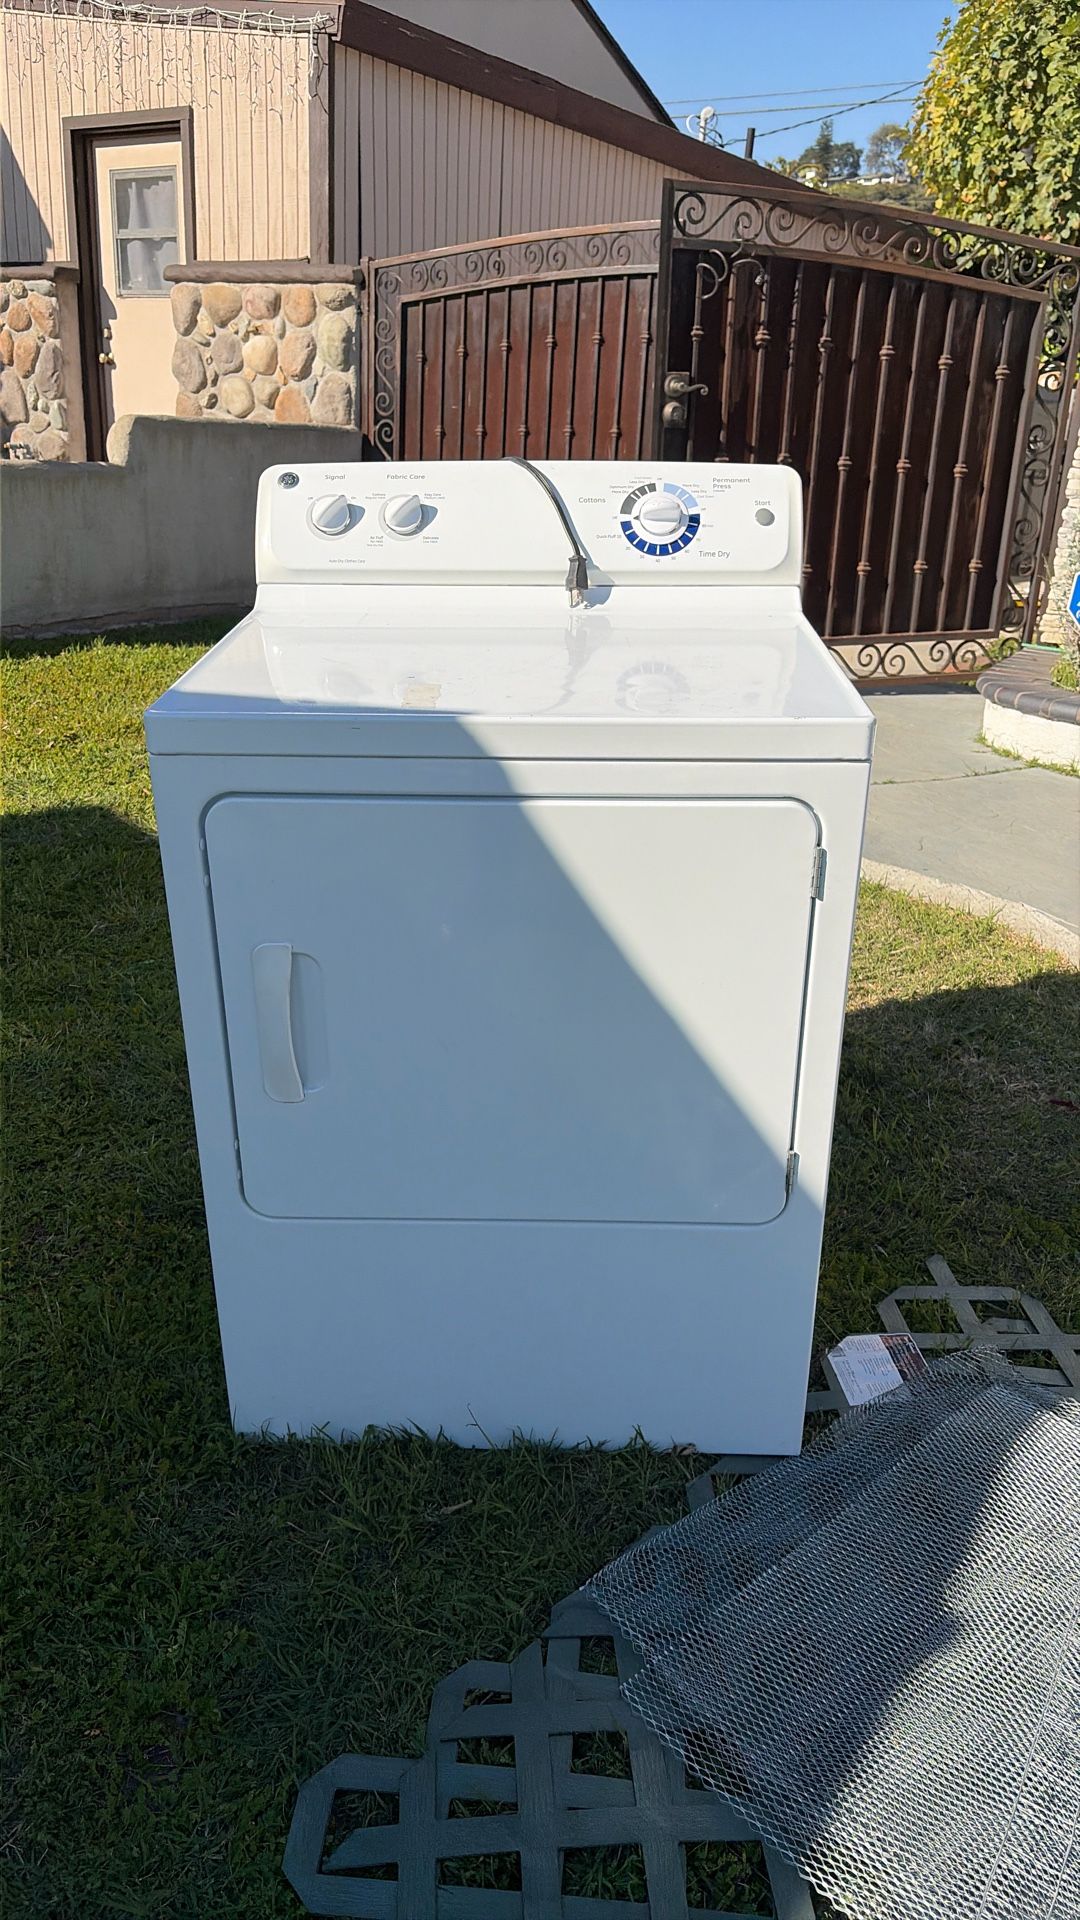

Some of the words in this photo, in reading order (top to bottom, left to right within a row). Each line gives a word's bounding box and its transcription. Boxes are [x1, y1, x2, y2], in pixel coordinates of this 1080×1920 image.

[324, 473, 346, 481] Signal
[699, 550, 717, 558] Time
[717, 550, 731, 559] Dry
